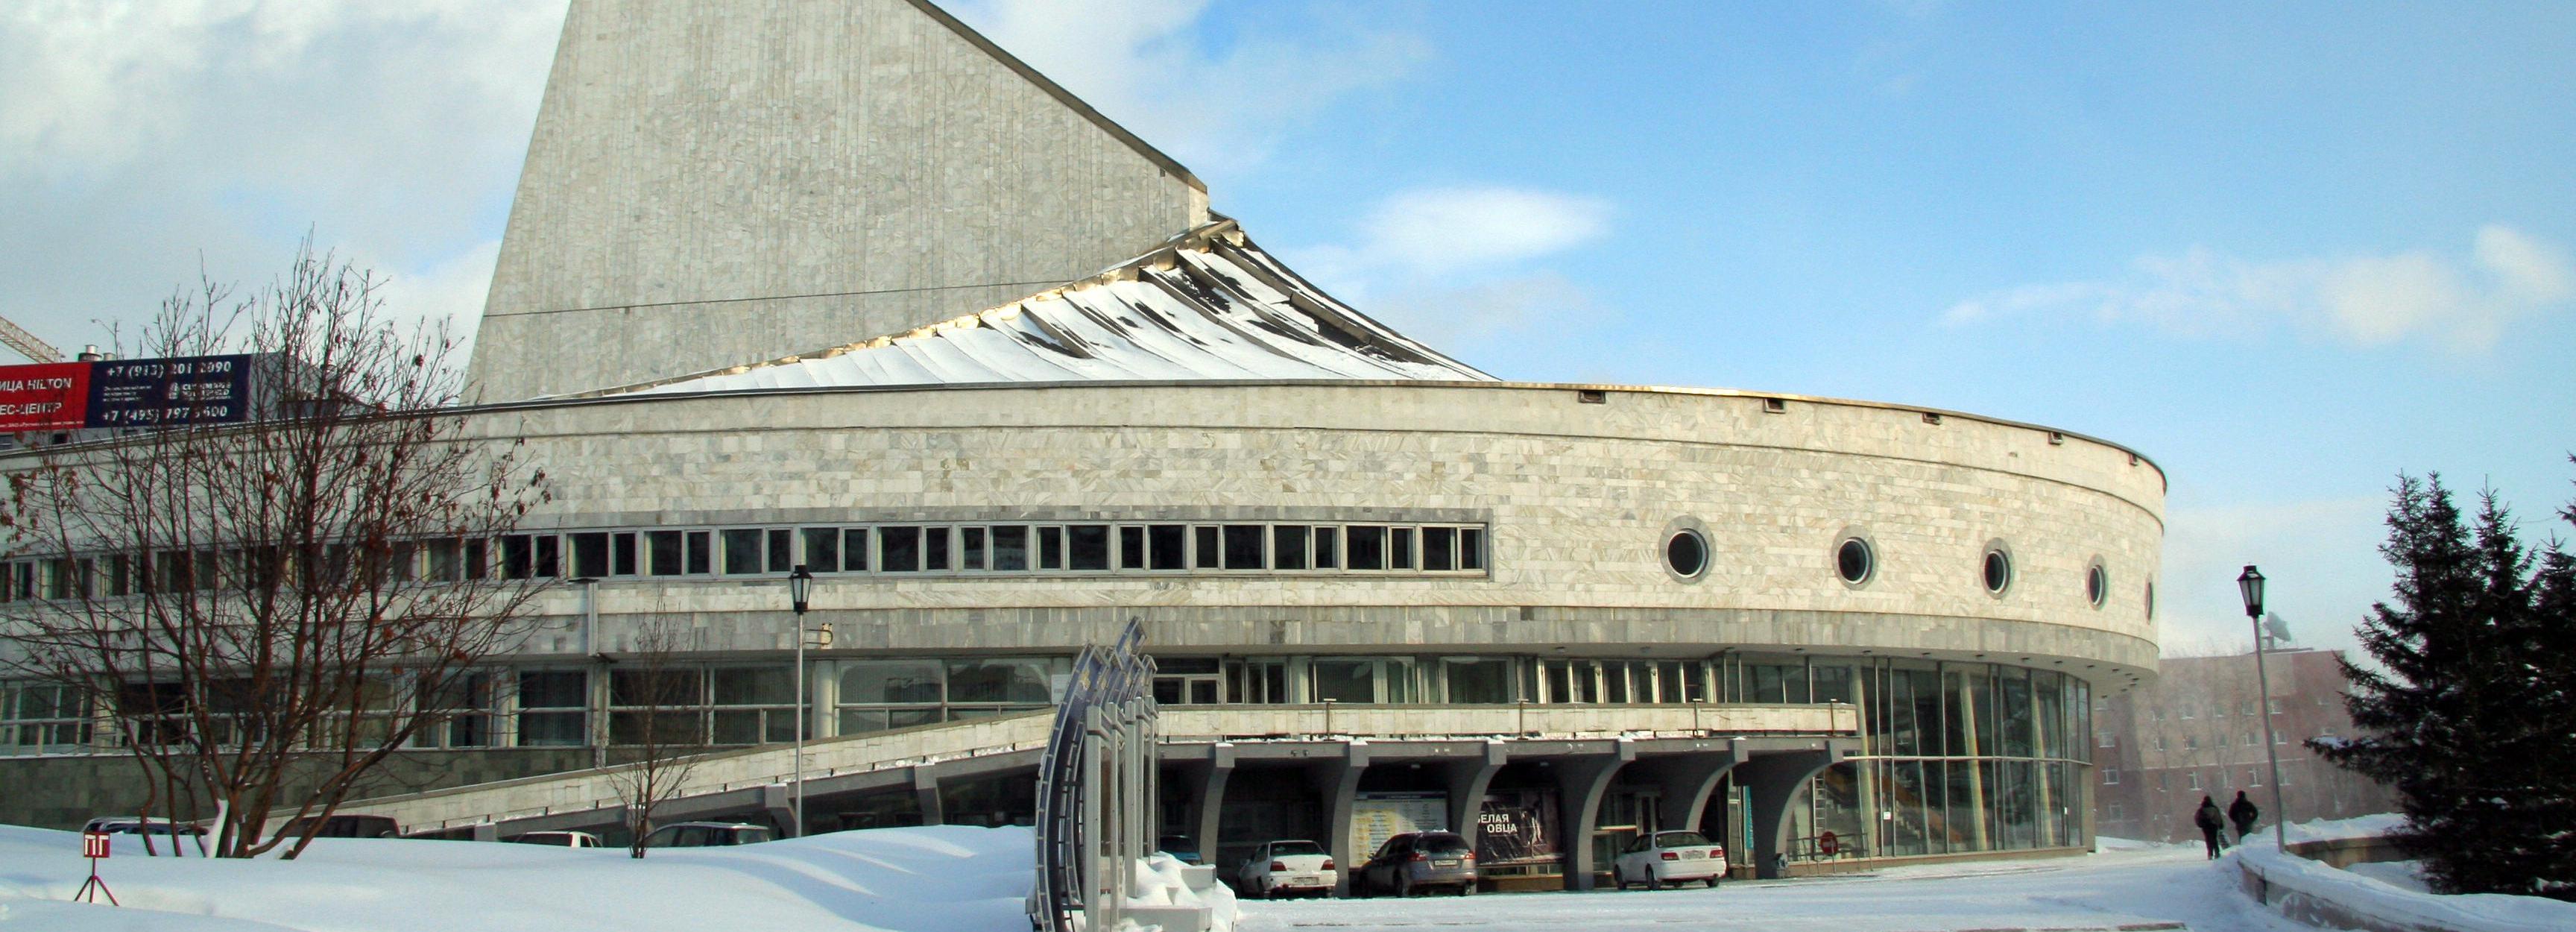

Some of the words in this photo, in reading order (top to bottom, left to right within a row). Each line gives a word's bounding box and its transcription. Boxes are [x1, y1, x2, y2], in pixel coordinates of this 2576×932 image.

[107, 365, 124, 377] +7
[28, 378, 72, 389] HILTON
[104, 410, 119, 421] +7
[166, 407, 189, 419] 797
[1478, 813, 1509, 823] ЕЛАЯ
[1487, 823, 1518, 834] ОВЦА
[84, 834, 109, 855] ПГ
